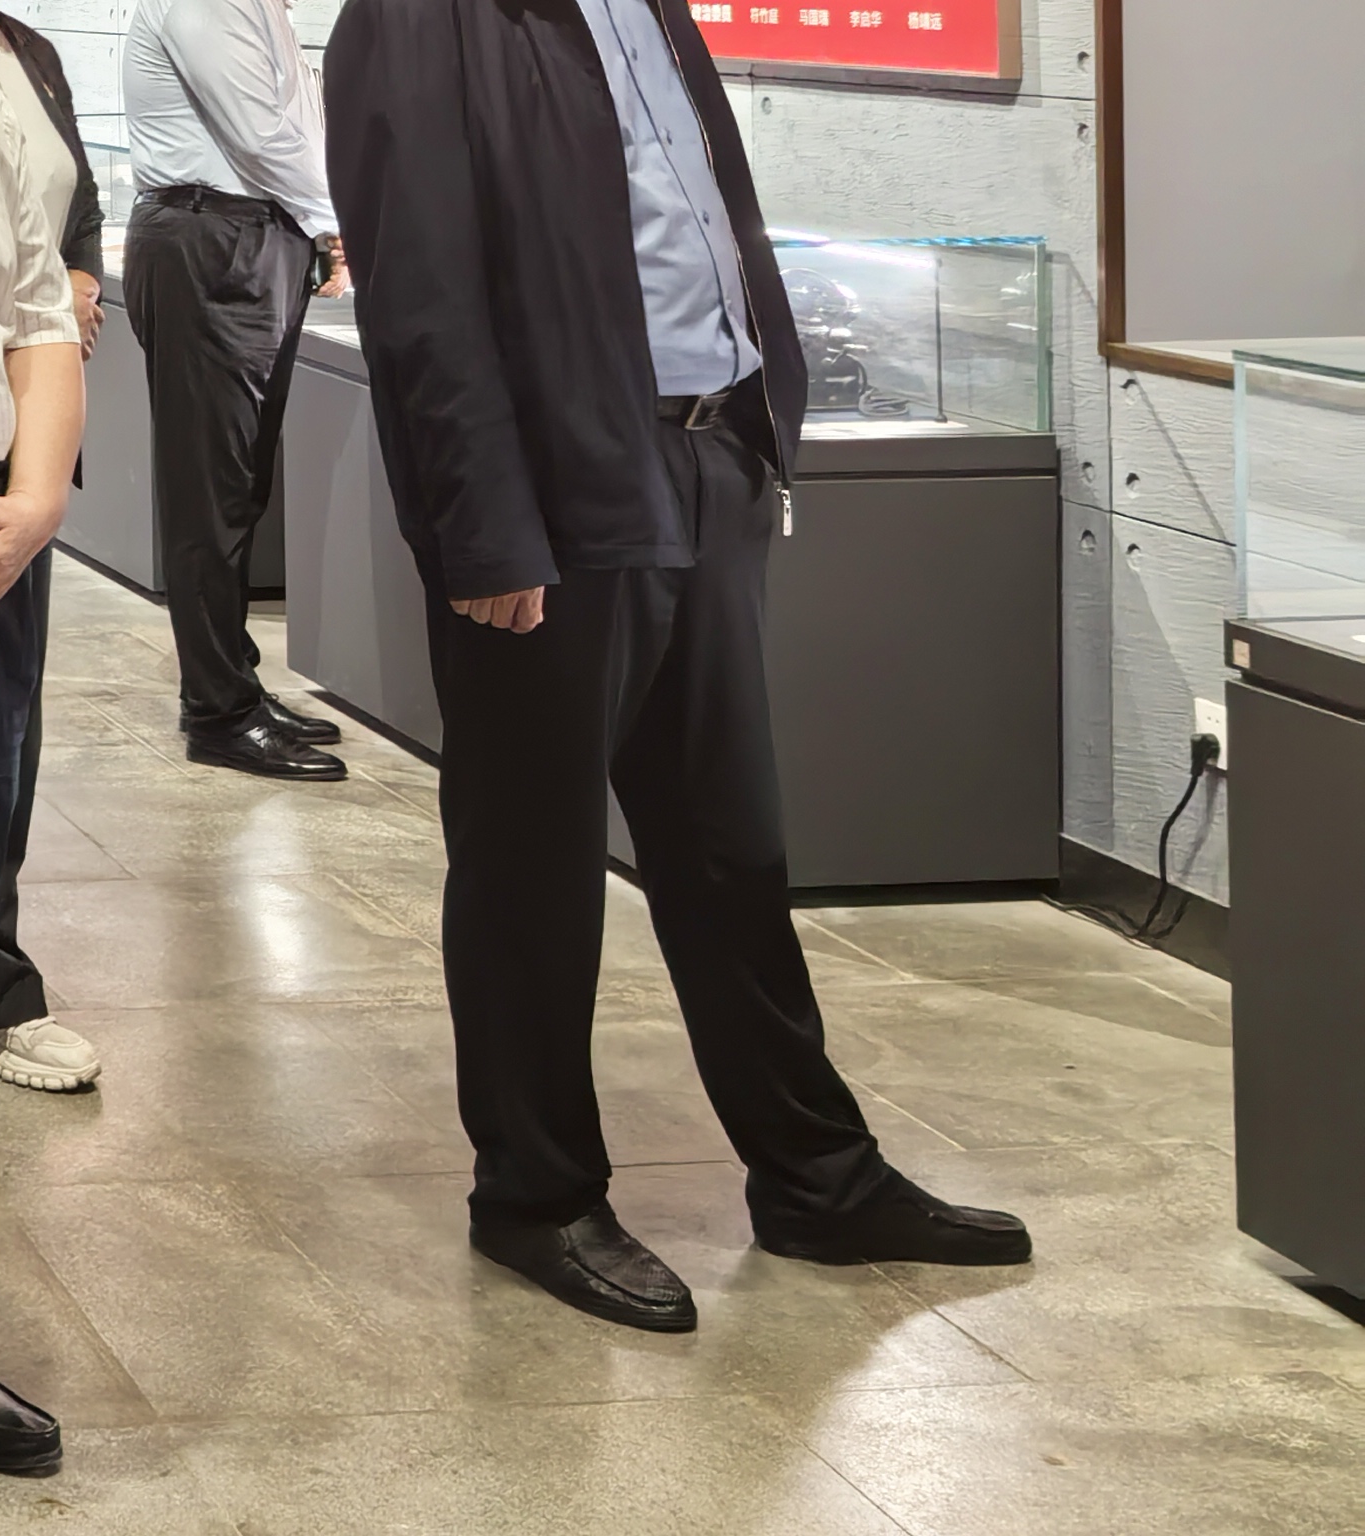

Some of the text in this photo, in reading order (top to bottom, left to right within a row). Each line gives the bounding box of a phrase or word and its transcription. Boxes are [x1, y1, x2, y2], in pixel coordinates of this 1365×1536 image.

[799, 9, 830, 26] 马国瑞
[907, 12, 943, 30] 杨靖远
